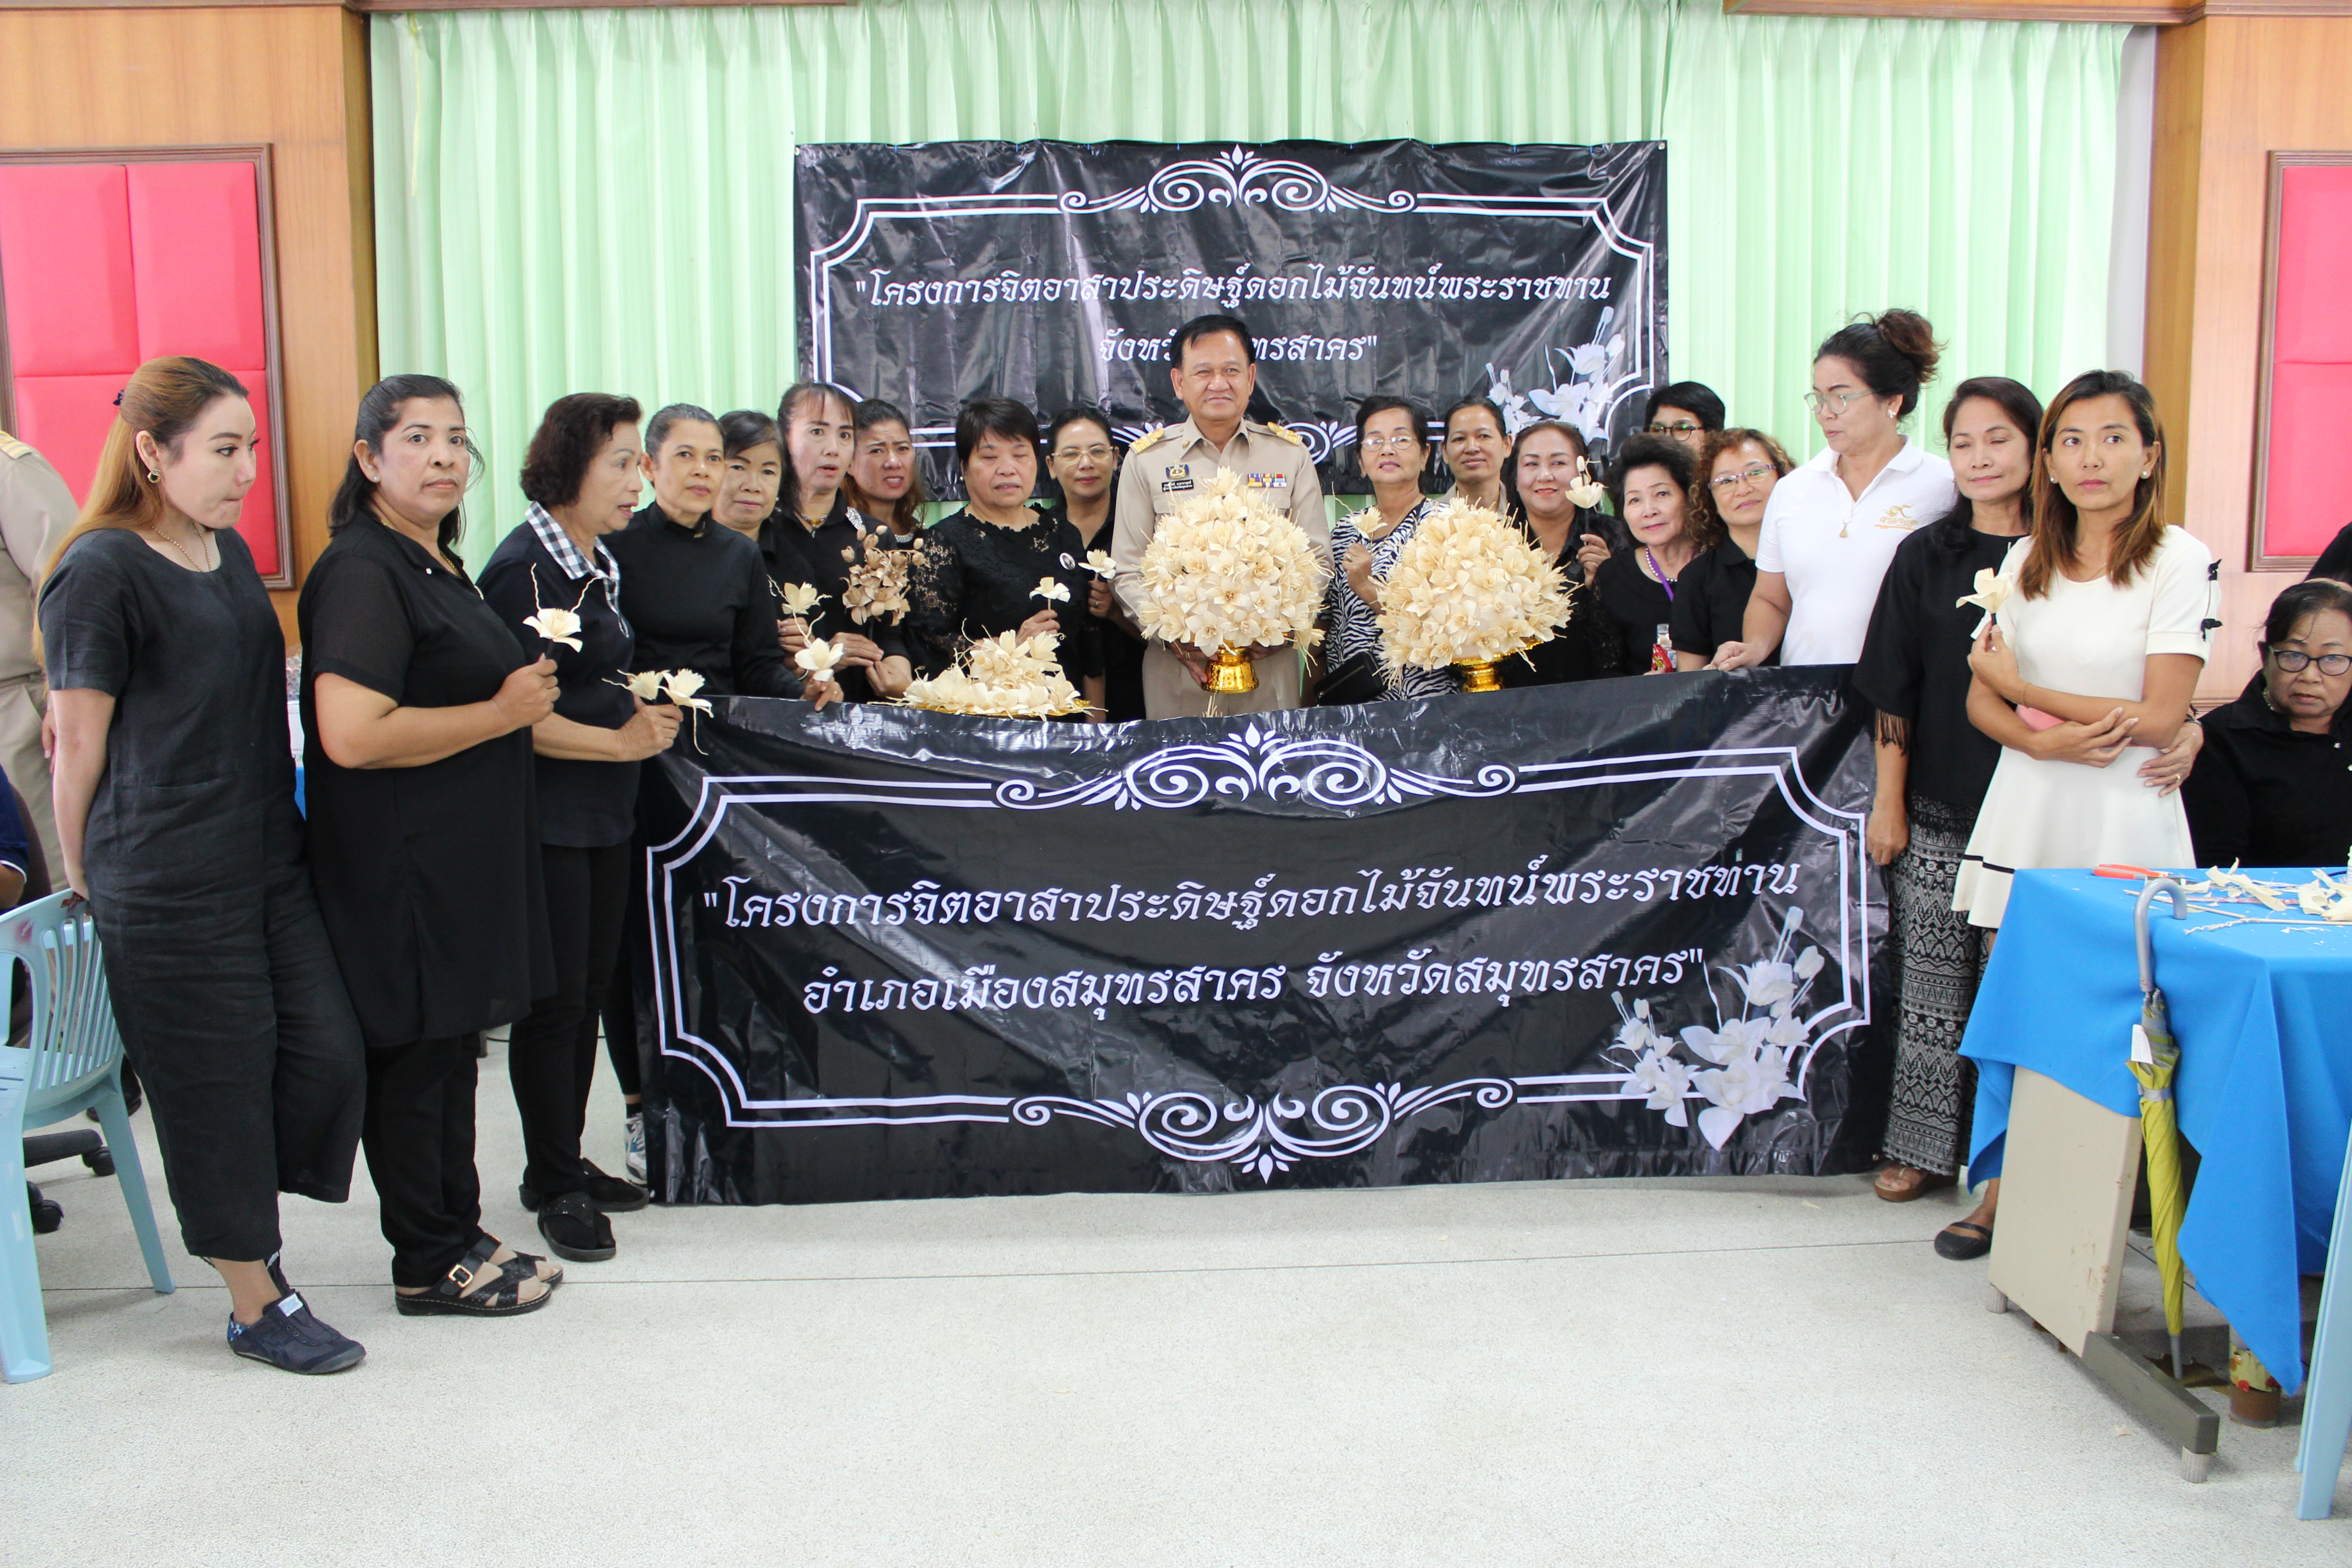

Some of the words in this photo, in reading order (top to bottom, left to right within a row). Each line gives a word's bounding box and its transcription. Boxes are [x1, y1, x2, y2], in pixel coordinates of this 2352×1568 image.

[855, 262, 1612, 308] "โครงการจิตอาสาประดิษฐ์ดอกไม้จันทน์พระราชทาน
[703, 855, 1801, 930] "โครงการจิตอาสาประดิษฐ์ดอกไม้จันทน์พระราชทาน
[804, 964, 1287, 1021] อำเภอเมืองสมุทรสาคร
[1307, 947, 1703, 1007] จังหวัดสมุทรสาคร"
